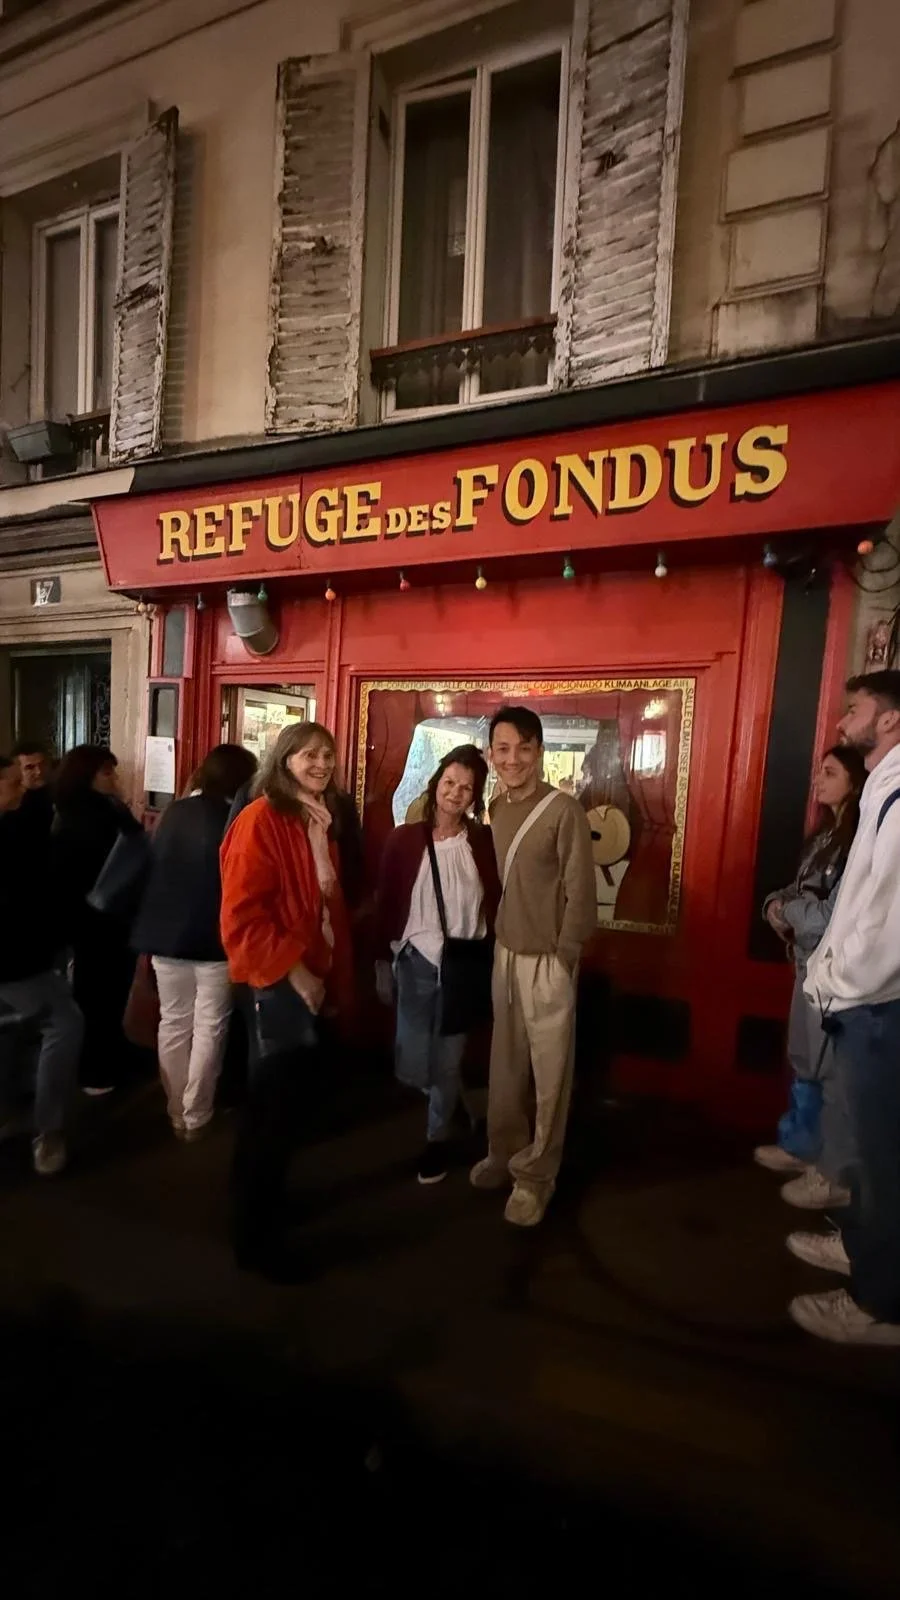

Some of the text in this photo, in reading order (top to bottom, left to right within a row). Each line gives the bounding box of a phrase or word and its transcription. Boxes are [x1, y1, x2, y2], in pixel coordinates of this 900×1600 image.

[158, 424, 789, 562] REFUGE DES FONDUS
[533, 680, 602, 690] CONDICIONADO
[604, 679, 672, 689] KLIMAANLAGE
[683, 687, 695, 717] SALLE
